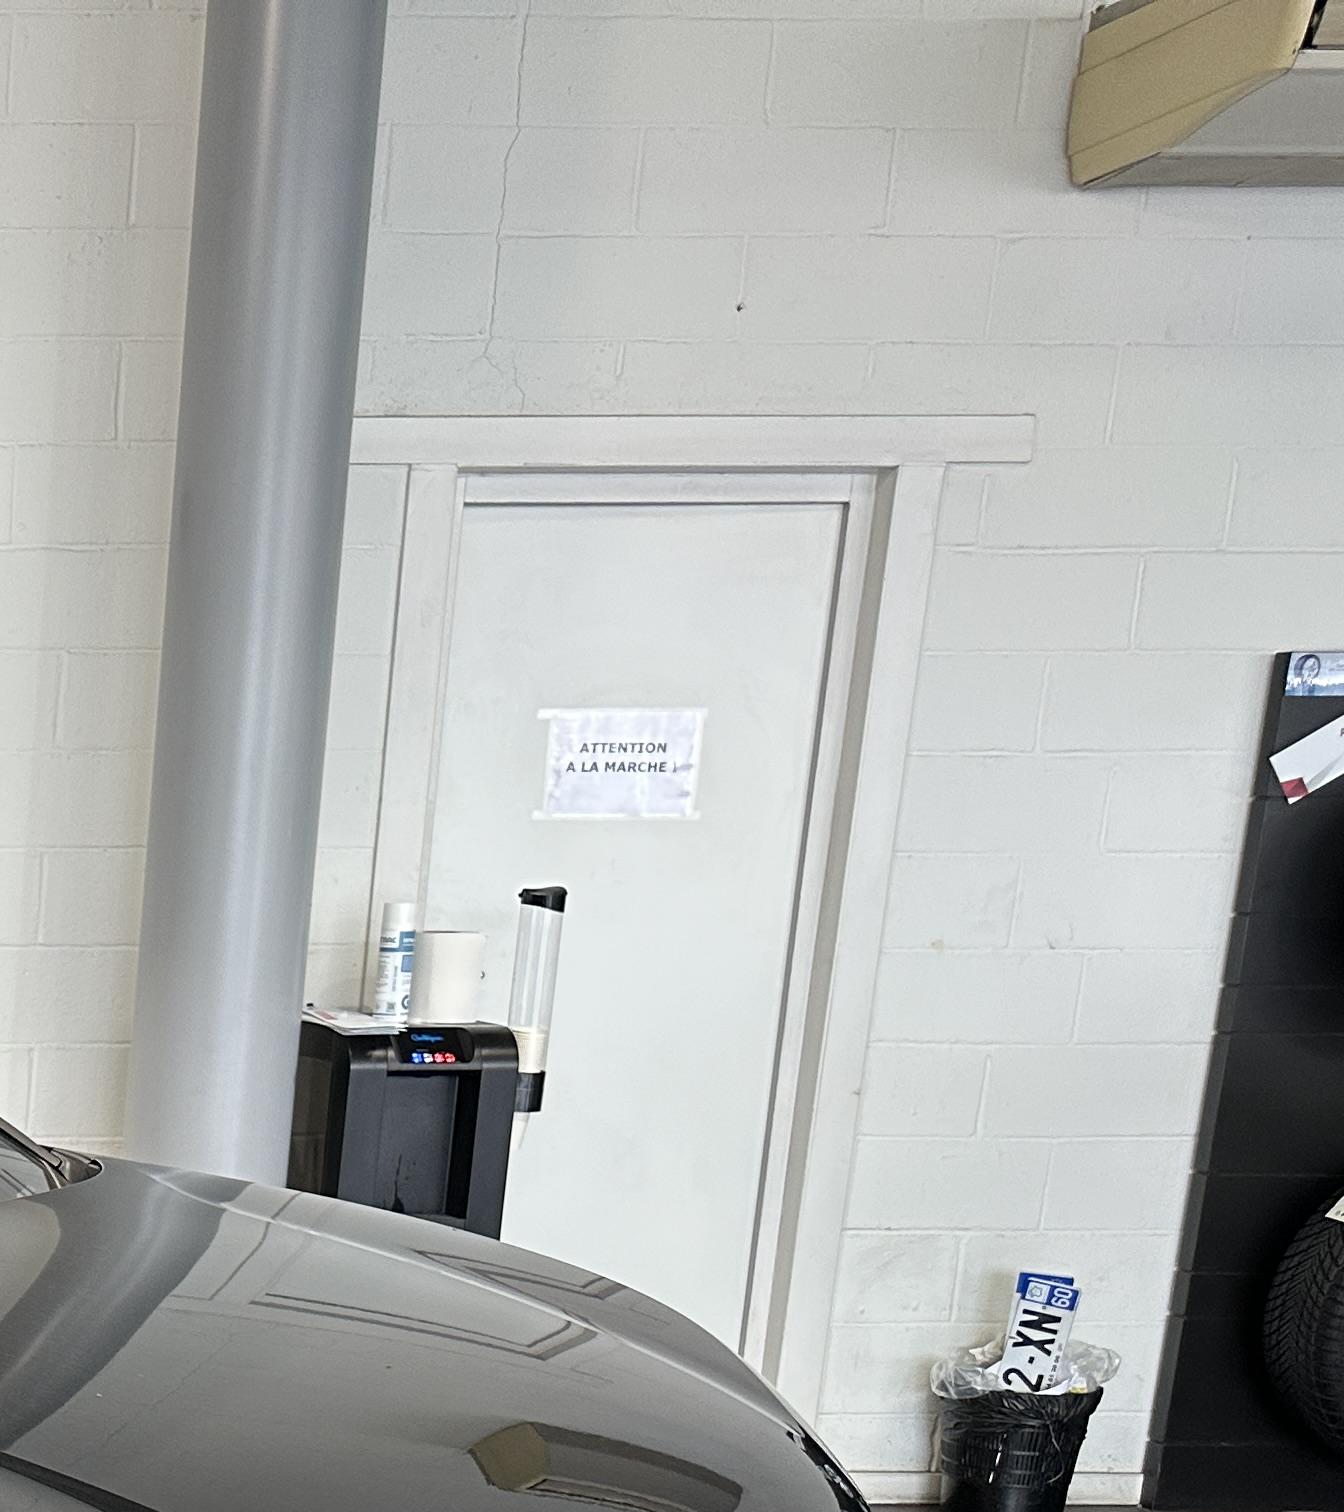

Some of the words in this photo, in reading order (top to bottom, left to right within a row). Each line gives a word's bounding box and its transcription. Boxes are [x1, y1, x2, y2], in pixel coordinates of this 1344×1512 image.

[579, 742, 668, 755] ATTENTION
[580, 761, 599, 773] LA
[604, 761, 668, 773] MARCHE
[1050, 1287, 1072, 1308] 60
